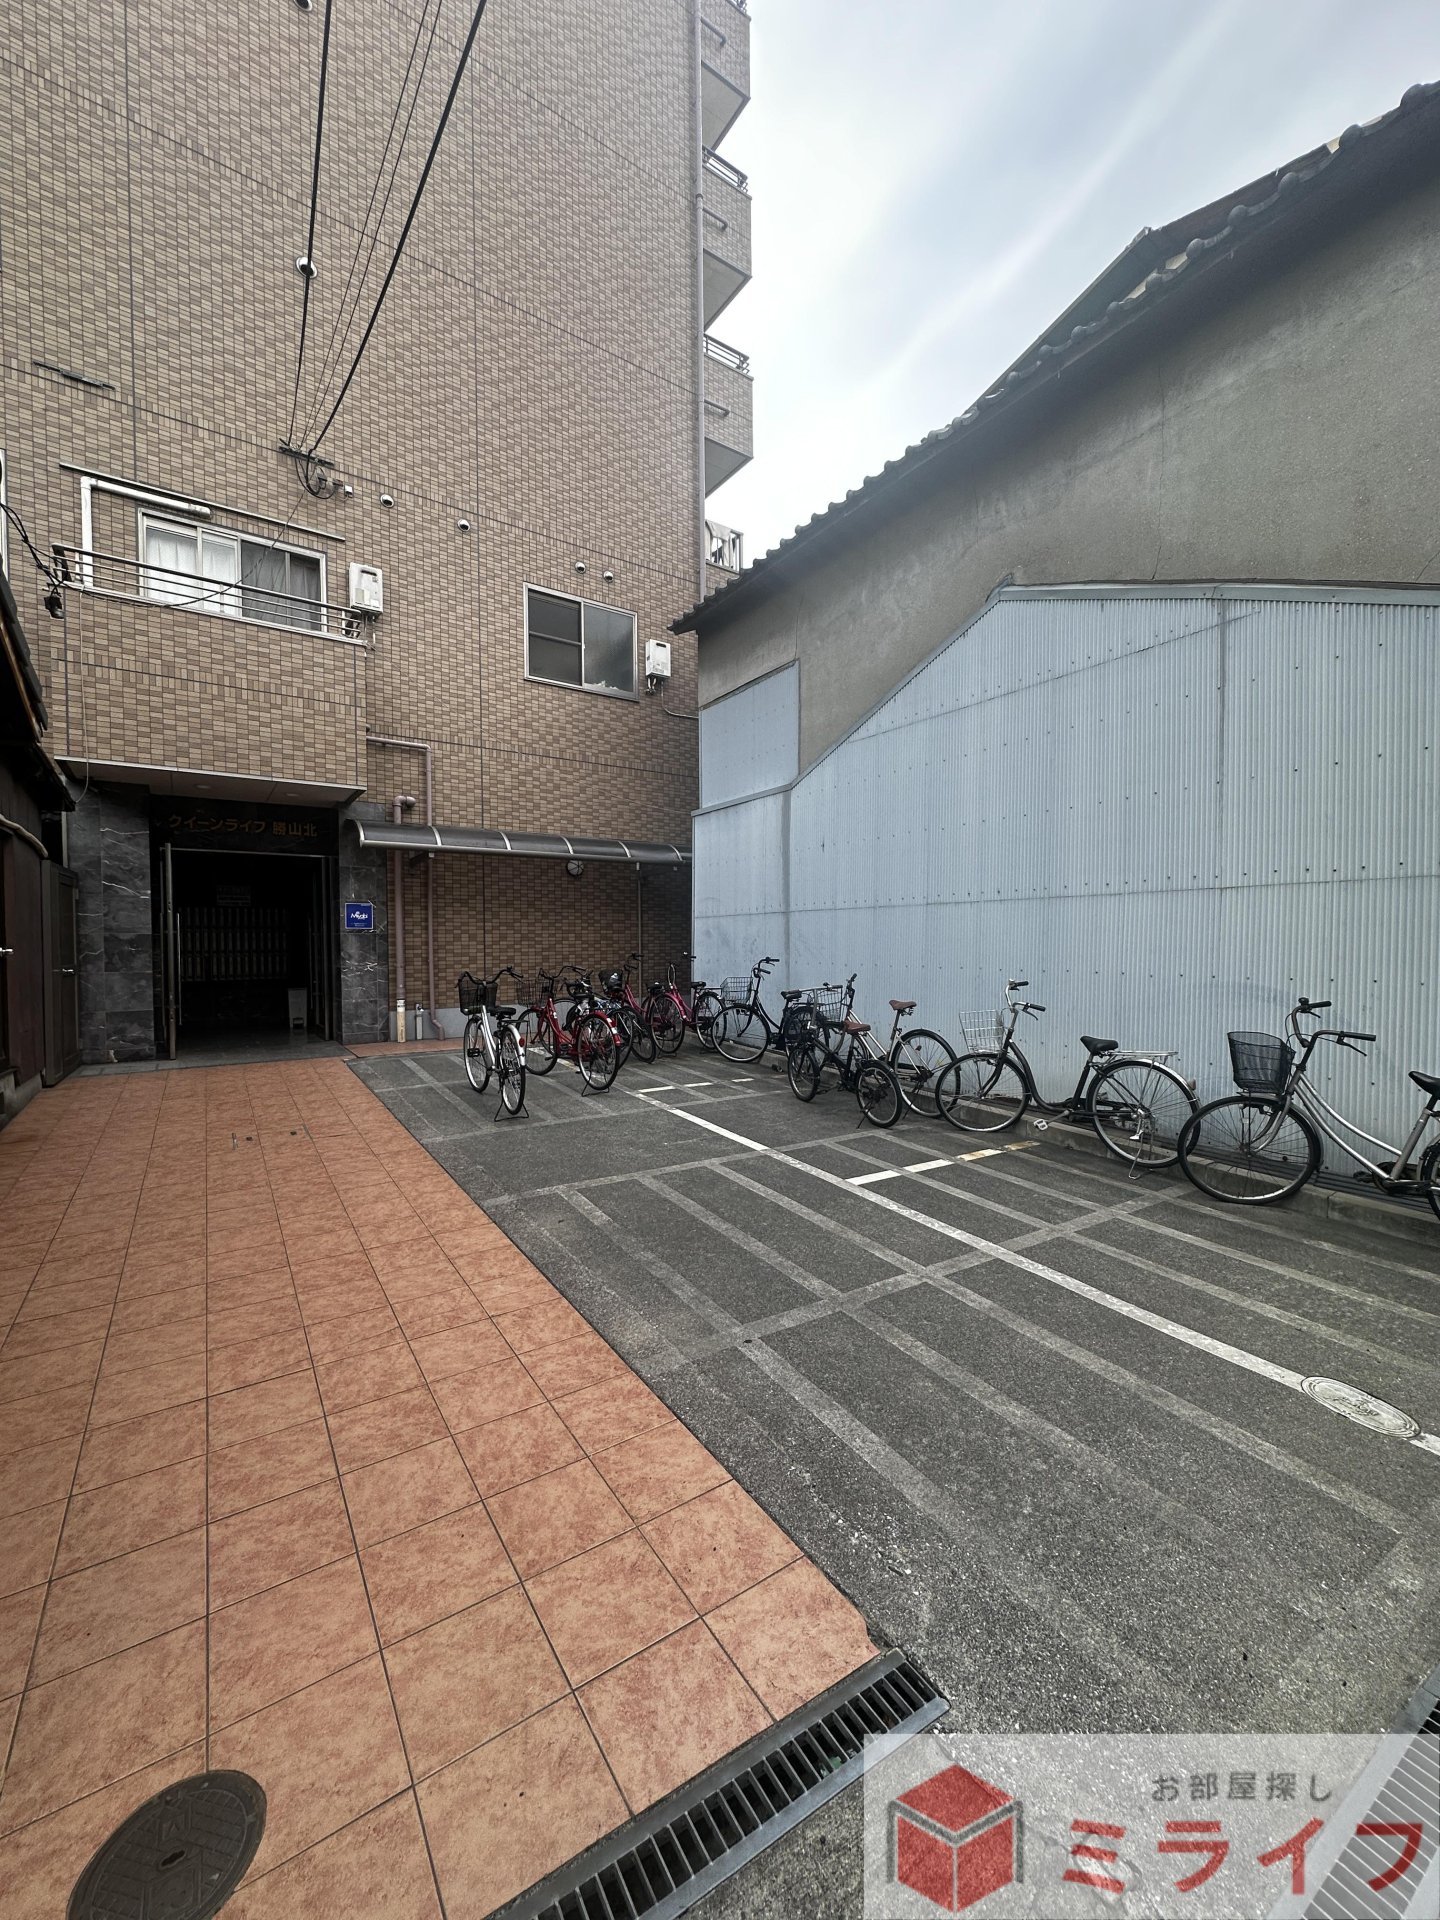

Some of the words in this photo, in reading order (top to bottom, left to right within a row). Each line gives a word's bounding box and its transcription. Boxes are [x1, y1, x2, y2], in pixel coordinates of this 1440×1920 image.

[168, 815, 267, 833] クイーンライフ
[272, 820, 318, 838] 勝山北
